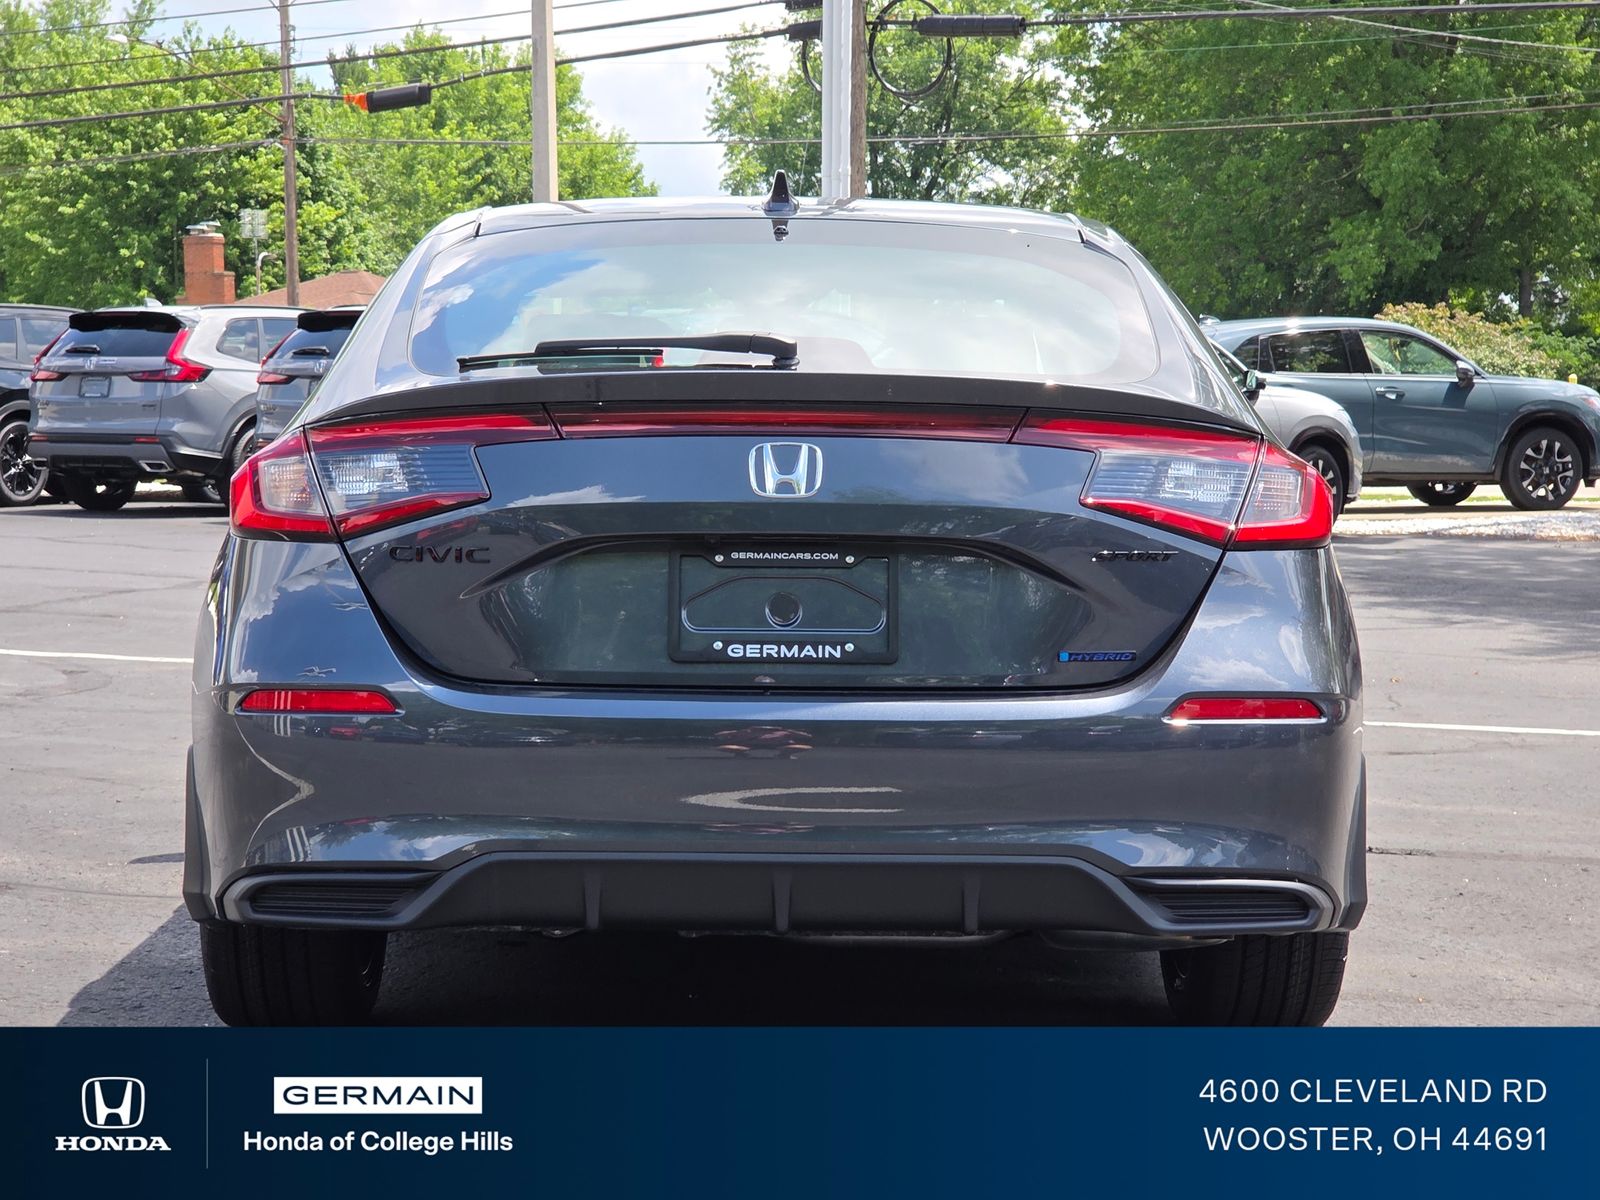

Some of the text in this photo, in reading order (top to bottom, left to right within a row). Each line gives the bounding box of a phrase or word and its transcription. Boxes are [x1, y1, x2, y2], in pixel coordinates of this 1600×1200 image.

[389, 545, 491, 563] CIVIC
[730, 552, 839, 561] GERMAINCARS.COM
[1091, 550, 1179, 562] SPORT
[727, 643, 841, 659] GERMAIN
[1070, 652, 1132, 661] HYBRID
